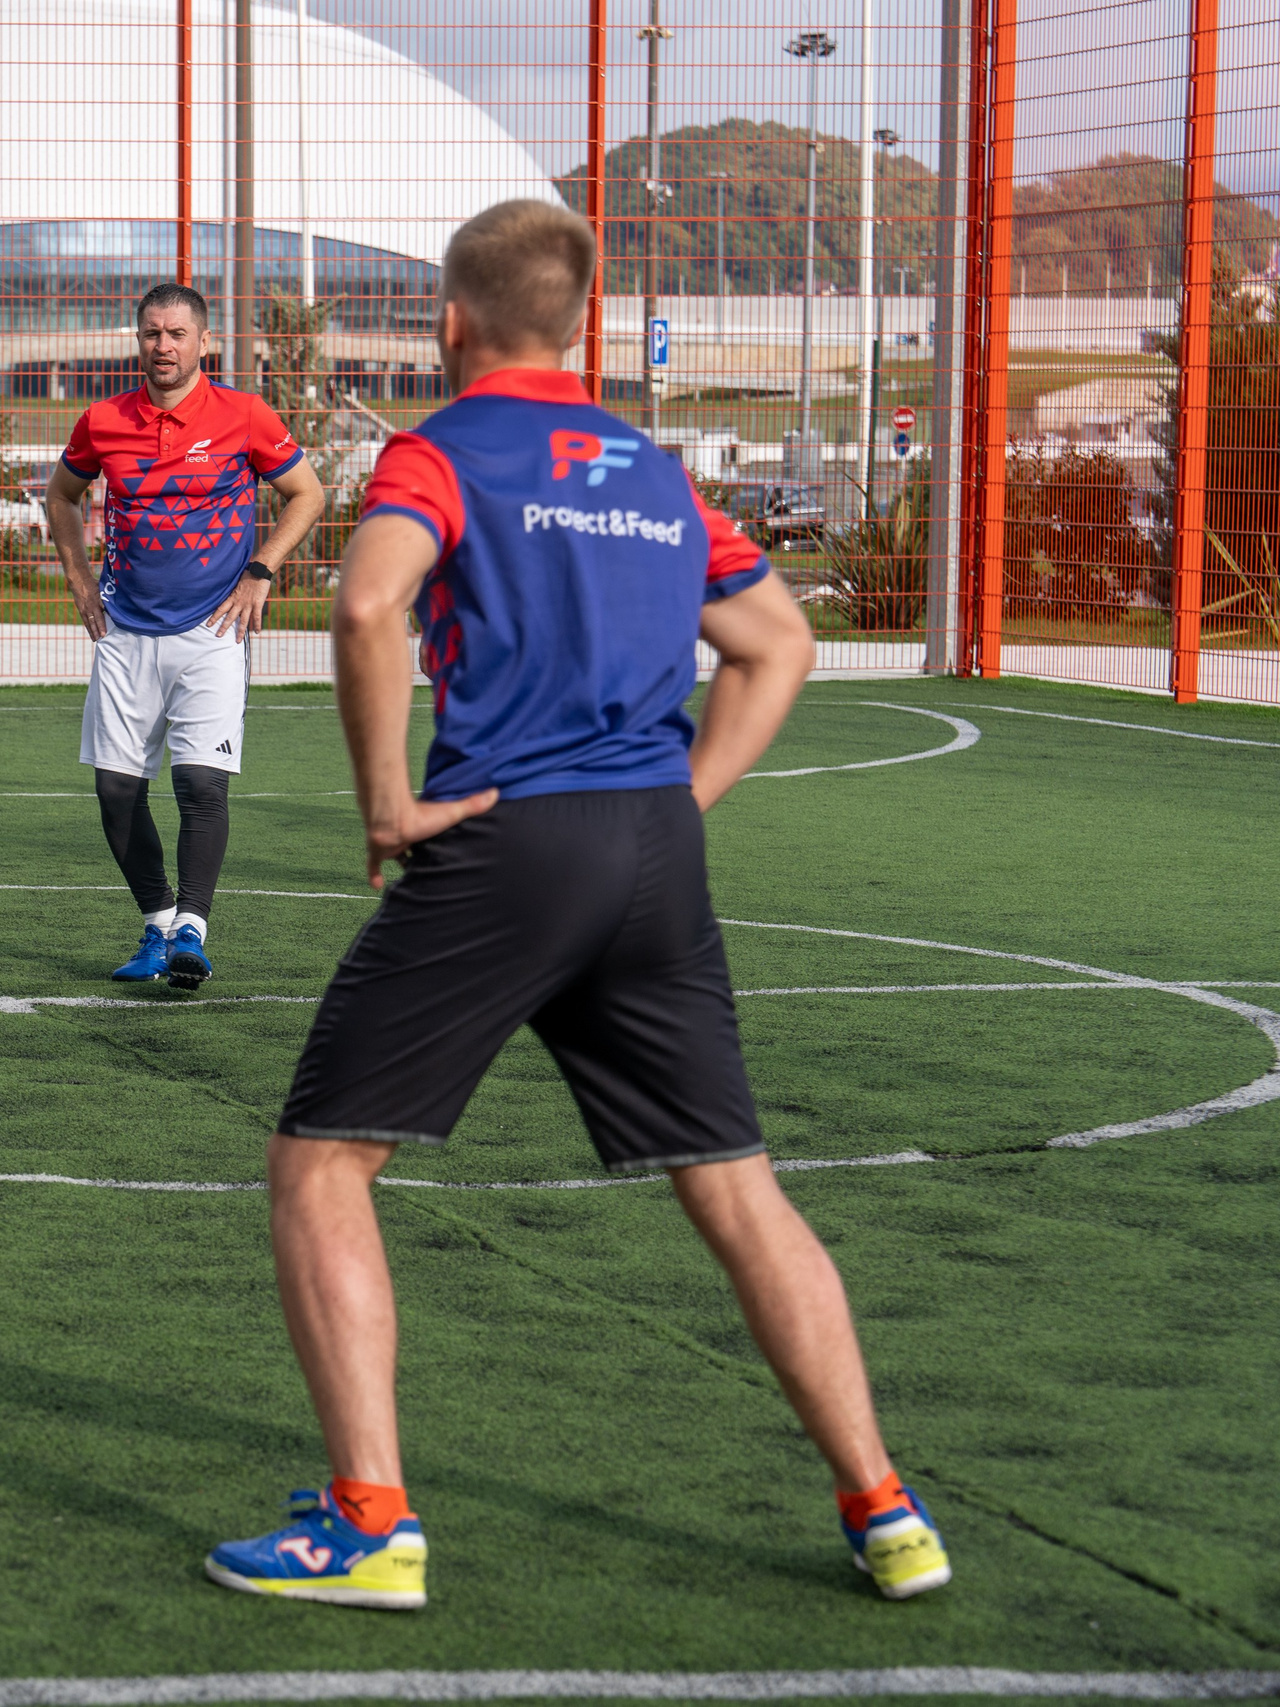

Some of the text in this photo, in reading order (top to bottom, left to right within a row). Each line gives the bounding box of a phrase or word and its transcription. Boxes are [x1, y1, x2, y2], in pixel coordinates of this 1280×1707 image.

[653, 323, 666, 361] P
[184, 454, 209, 463] feed
[522, 502, 684, 546] Proect&Feed
